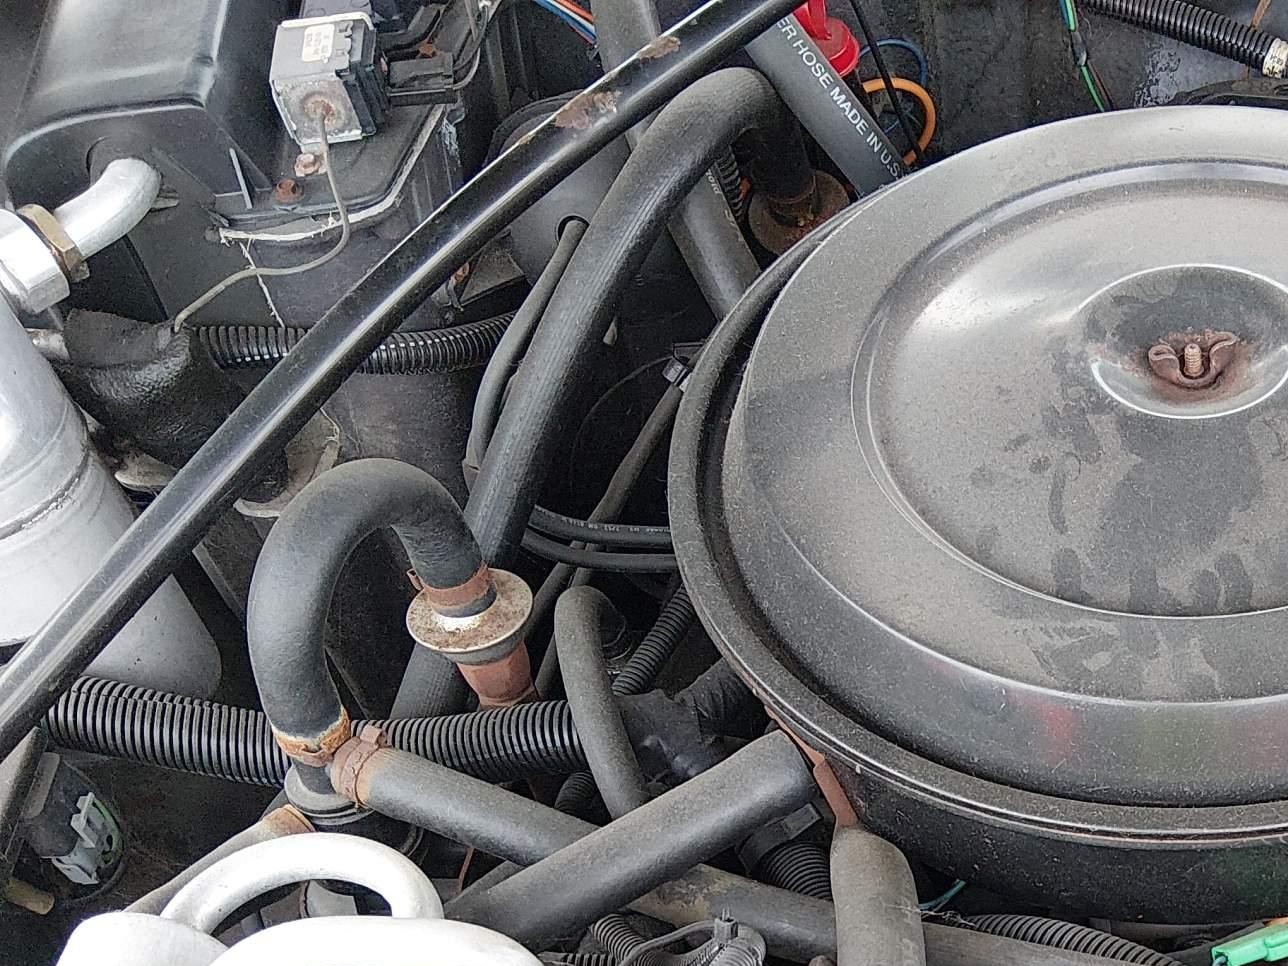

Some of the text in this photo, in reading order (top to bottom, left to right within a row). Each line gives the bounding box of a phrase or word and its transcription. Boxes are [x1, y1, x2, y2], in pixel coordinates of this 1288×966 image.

[776, 16, 907, 181] ER HOSE MADE IN U.S.
